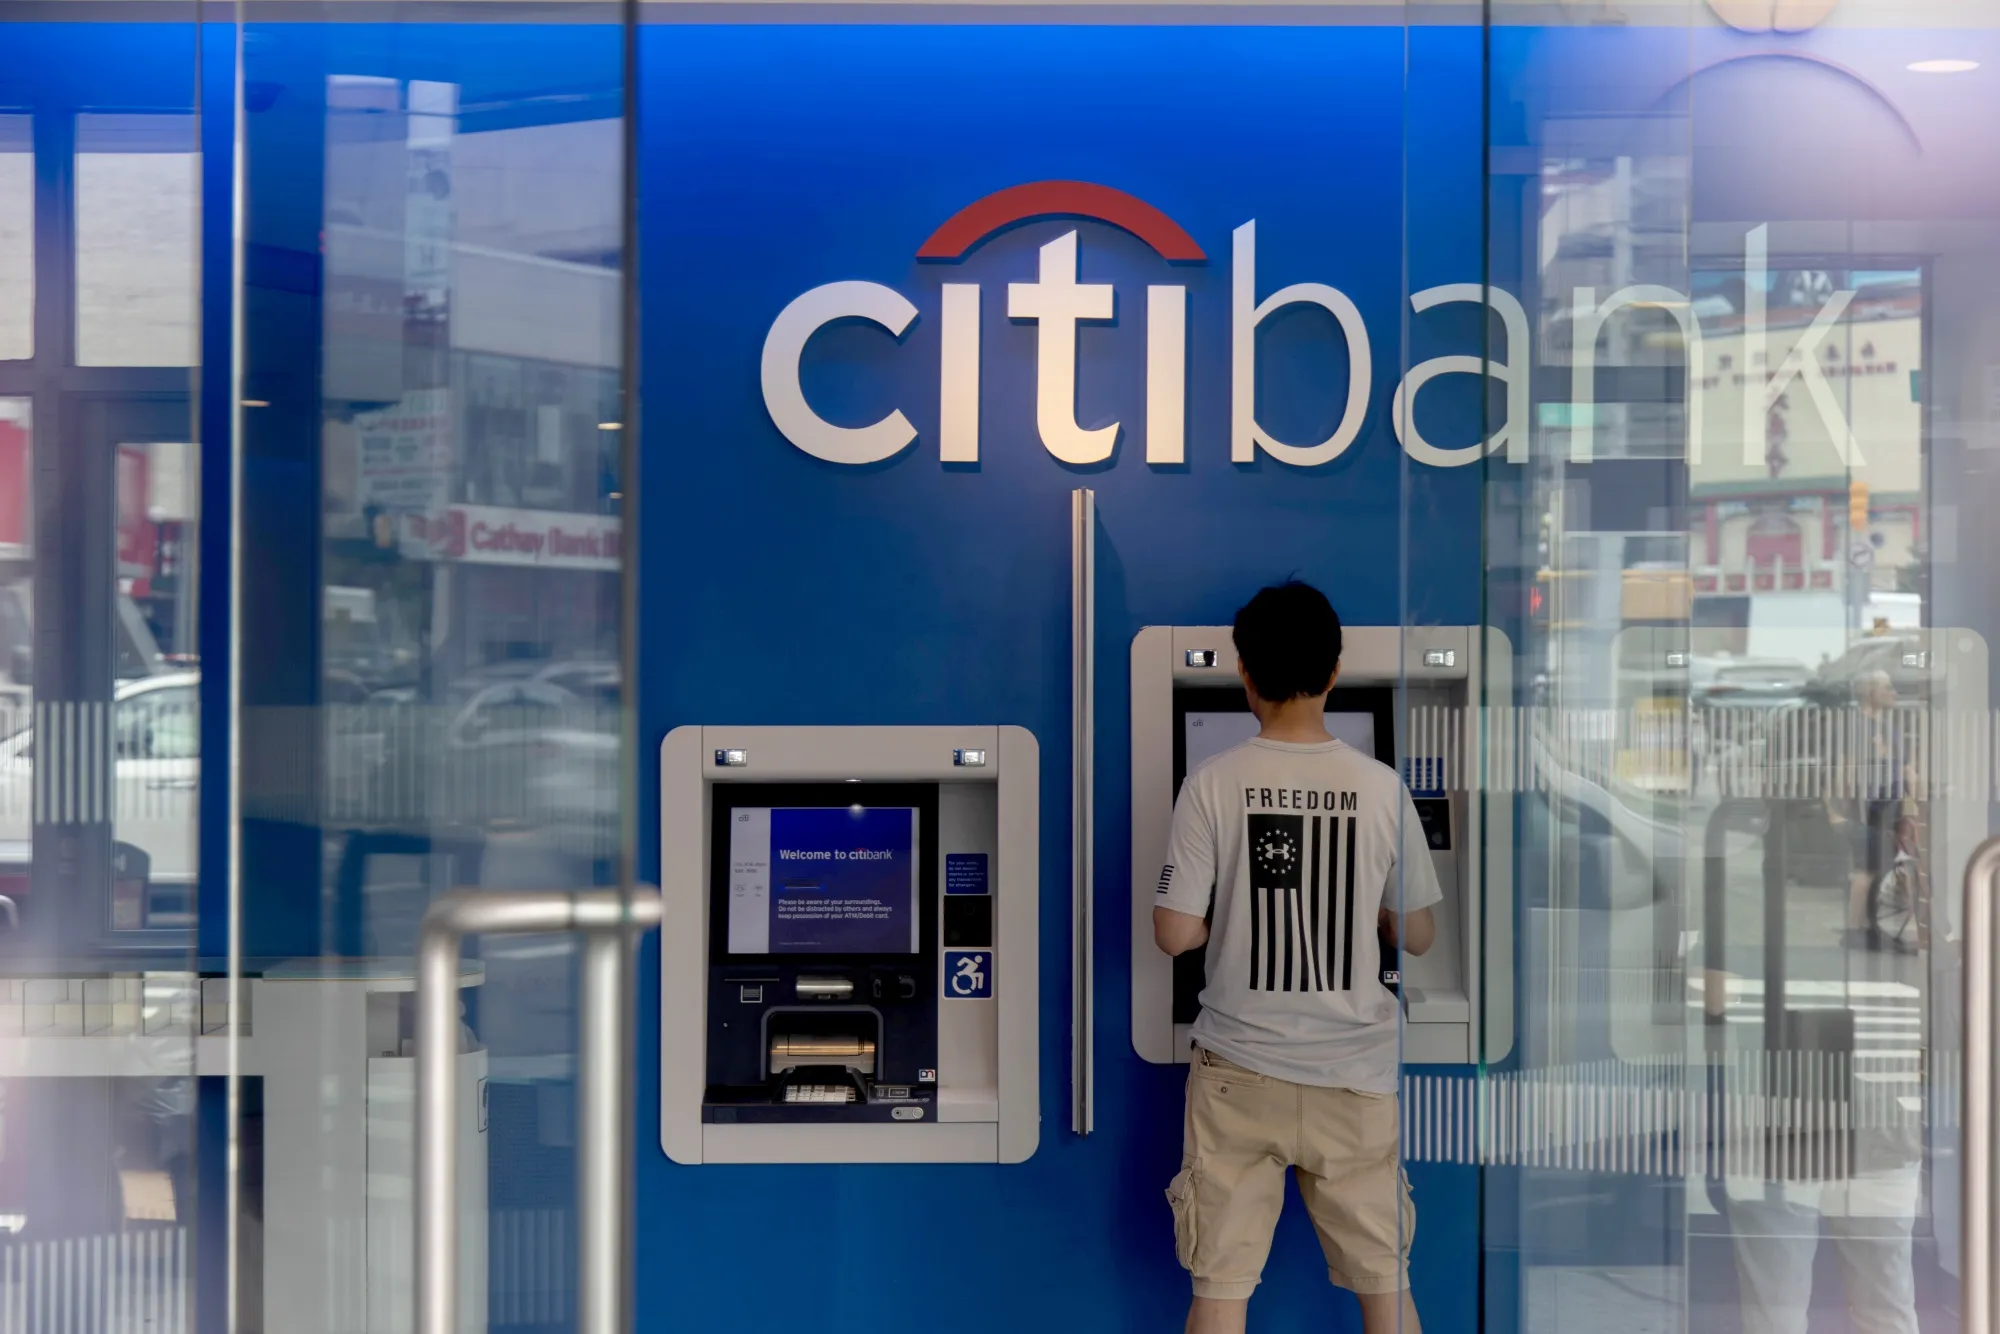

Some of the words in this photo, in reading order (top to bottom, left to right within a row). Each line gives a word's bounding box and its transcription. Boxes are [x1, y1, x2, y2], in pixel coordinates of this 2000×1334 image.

[760, 218, 1868, 468] citibank
[1192, 718, 1204, 727] citi
[1245, 788, 1357, 811] FREEDOM
[779, 849, 831, 860] Welcome
[834, 849, 847, 860] to
[849, 848, 892, 860] citibank
